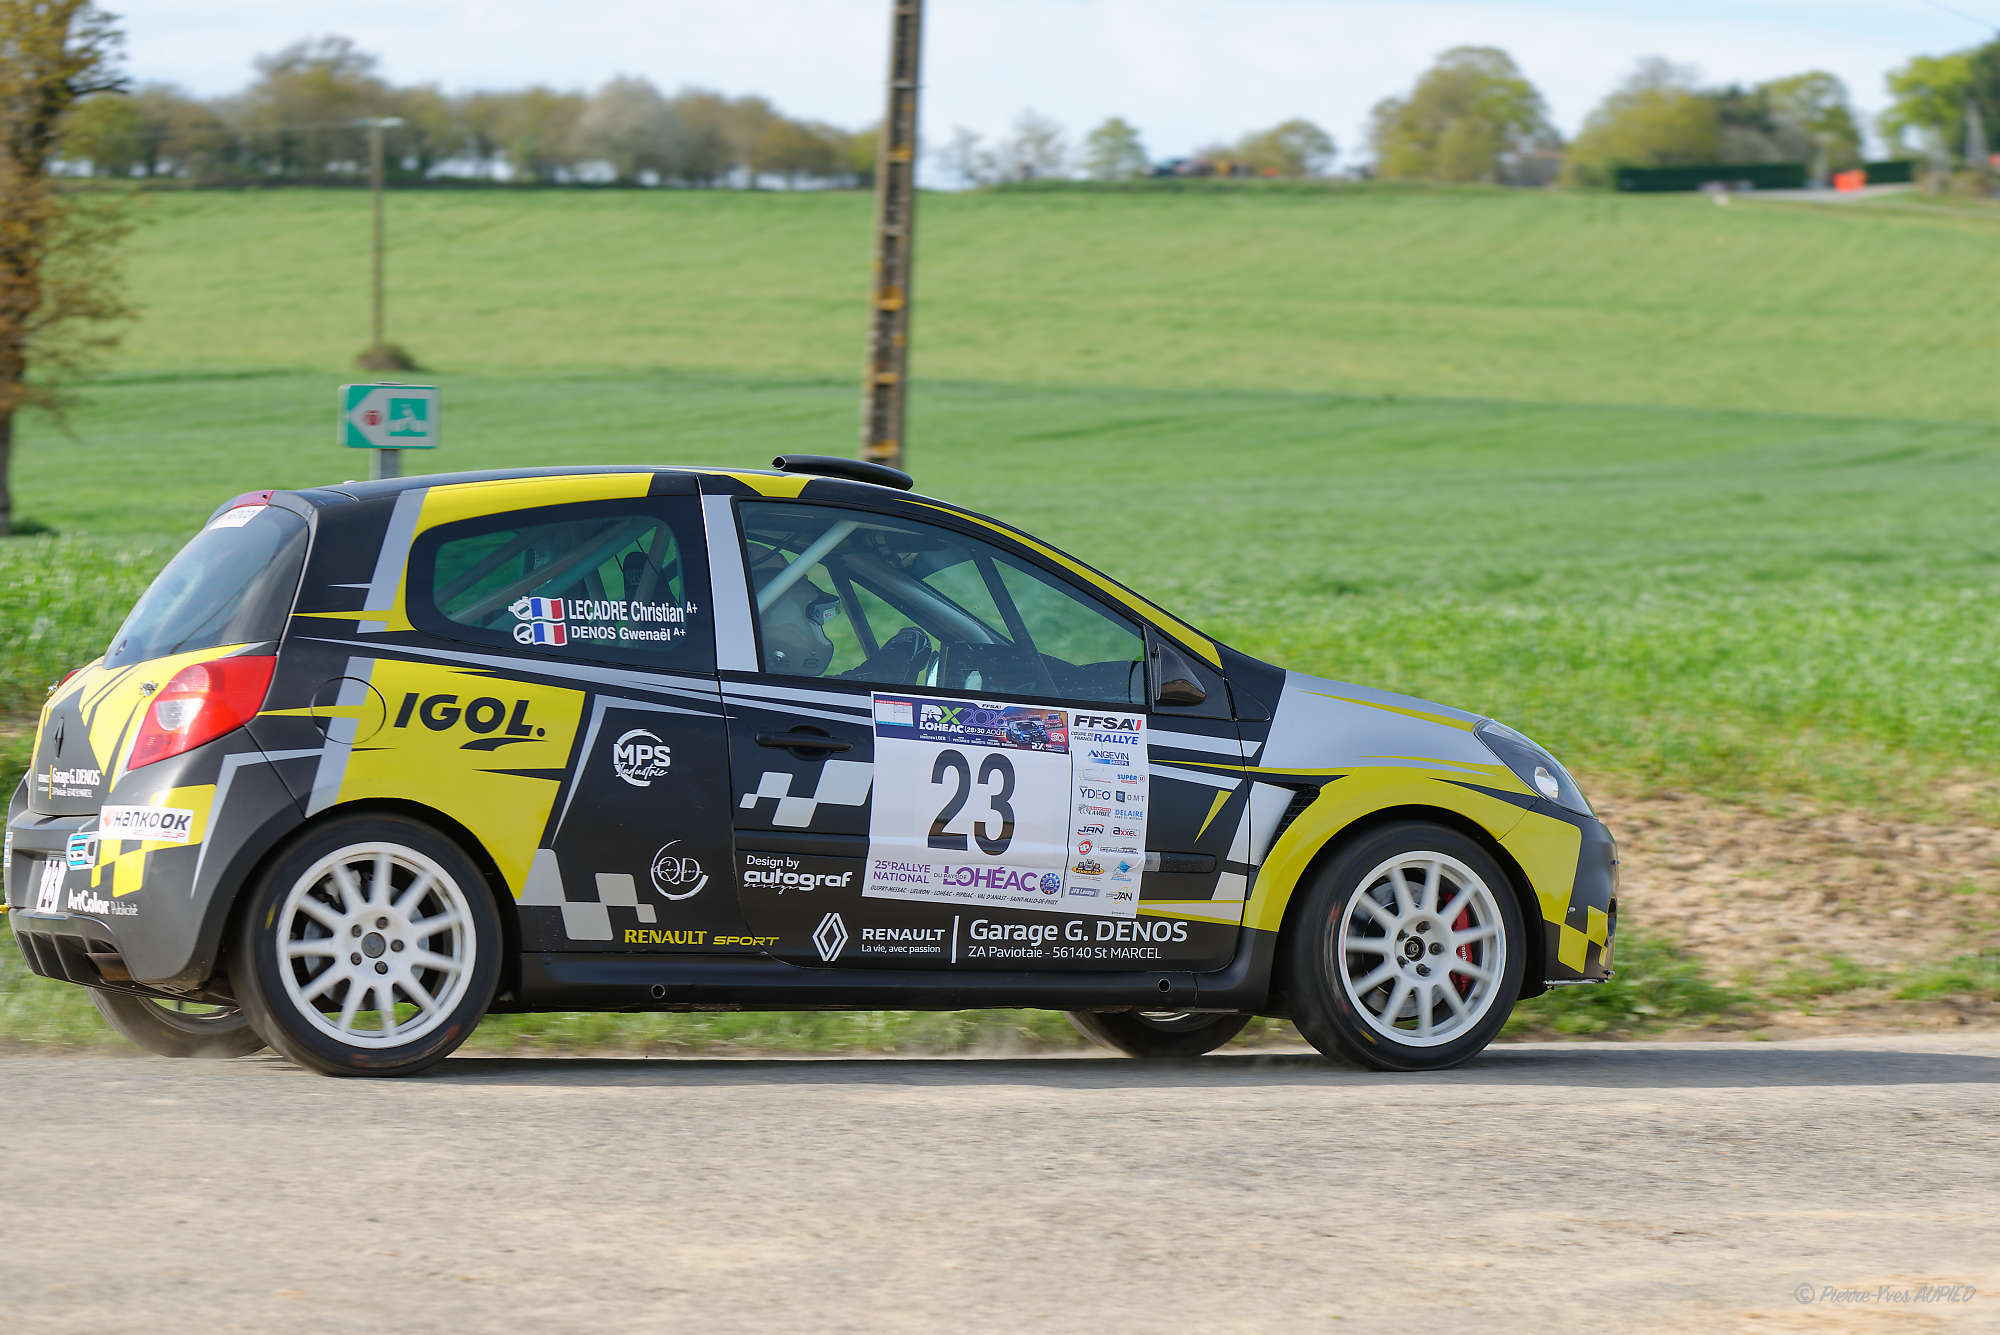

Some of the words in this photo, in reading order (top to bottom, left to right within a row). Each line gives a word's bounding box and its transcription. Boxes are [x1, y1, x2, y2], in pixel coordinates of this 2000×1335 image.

[568, 600, 628, 621] LECADRE
[631, 600, 685, 623] Christian
[686, 601, 698, 614] A+
[571, 626, 616, 639] DENOS
[619, 626, 671, 641] Gwenaël
[673, 628, 686, 637] A+
[393, 692, 546, 737] IGOL.
[920, 704, 963, 725] RX
[919, 722, 964, 733] LOHEAC
[1093, 734, 1139, 745] RALLYE
[613, 743, 671, 767] MPS
[1088, 749, 1130, 760] ANGEVIN
[75, 769, 101, 786] DENOS
[615, 762, 668, 779] Industrie
[1116, 773, 1138, 781] SUPER
[1079, 788, 1111, 800] YDEO
[927, 749, 1016, 856] 23
[1115, 809, 1144, 818] DELAIRE
[1077, 826, 1104, 834] JAN
[746, 855, 783, 869] Design
[786, 857, 800, 870] by
[891, 861, 931, 873] RALLYE
[743, 868, 853, 891] autograf
[873, 871, 930, 884] NATIONAL
[943, 866, 1038, 892] LOHÉAC
[67, 888, 110, 914] ArtColor
[624, 929, 708, 945] RENAULT
[712, 935, 780, 946] SPORT
[861, 928, 946, 941] RENAULT
[970, 918, 1059, 946] Garage
[1065, 919, 1089, 942] G.
[1096, 920, 1188, 943] DENOS
[861, 944, 872, 952] La
[873, 944, 888, 954] vie,
[909, 944, 941, 955] passion
[968, 946, 986, 958] ZA
[988, 946, 1043, 958] Paviotaie
[1052, 946, 1092, 958] 56140
[1094, 947, 1107, 959] St
[1110, 947, 1162, 959] MARCEL
